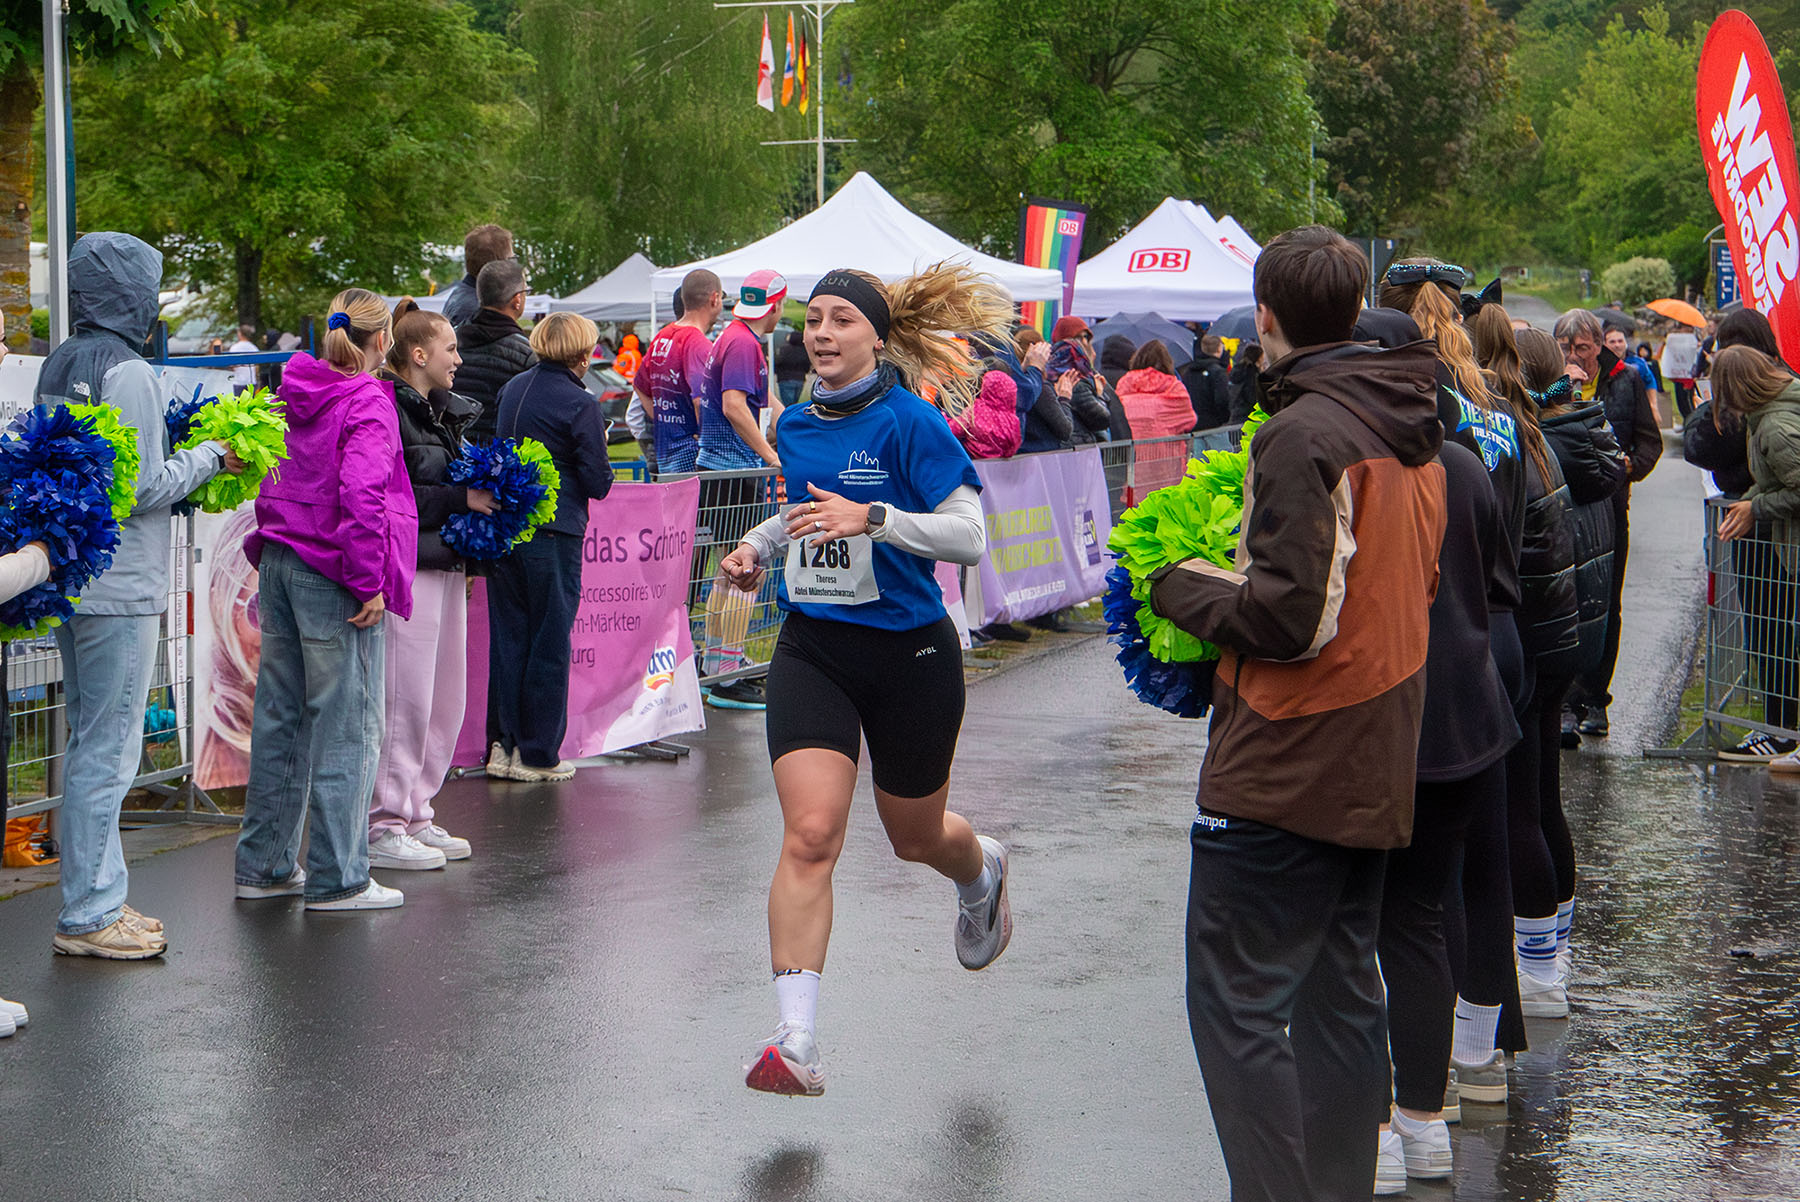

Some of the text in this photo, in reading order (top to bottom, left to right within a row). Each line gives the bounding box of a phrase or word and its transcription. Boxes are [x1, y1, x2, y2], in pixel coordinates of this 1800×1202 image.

[1060, 220, 1078, 234] DB
[1135, 251, 1183, 270] DB
[584, 526, 687, 563] das Schöne
[800, 538, 851, 570] 1268
[815, 574, 837, 584] Theresa
[580, 583, 667, 603] Accessoires von
[795, 587, 808, 596] Abtei
[572, 611, 641, 634] m-Märkten
[571, 648, 595, 668] urg
[915, 646, 937, 657] AYBL
[1196, 812, 1228, 831] empa
